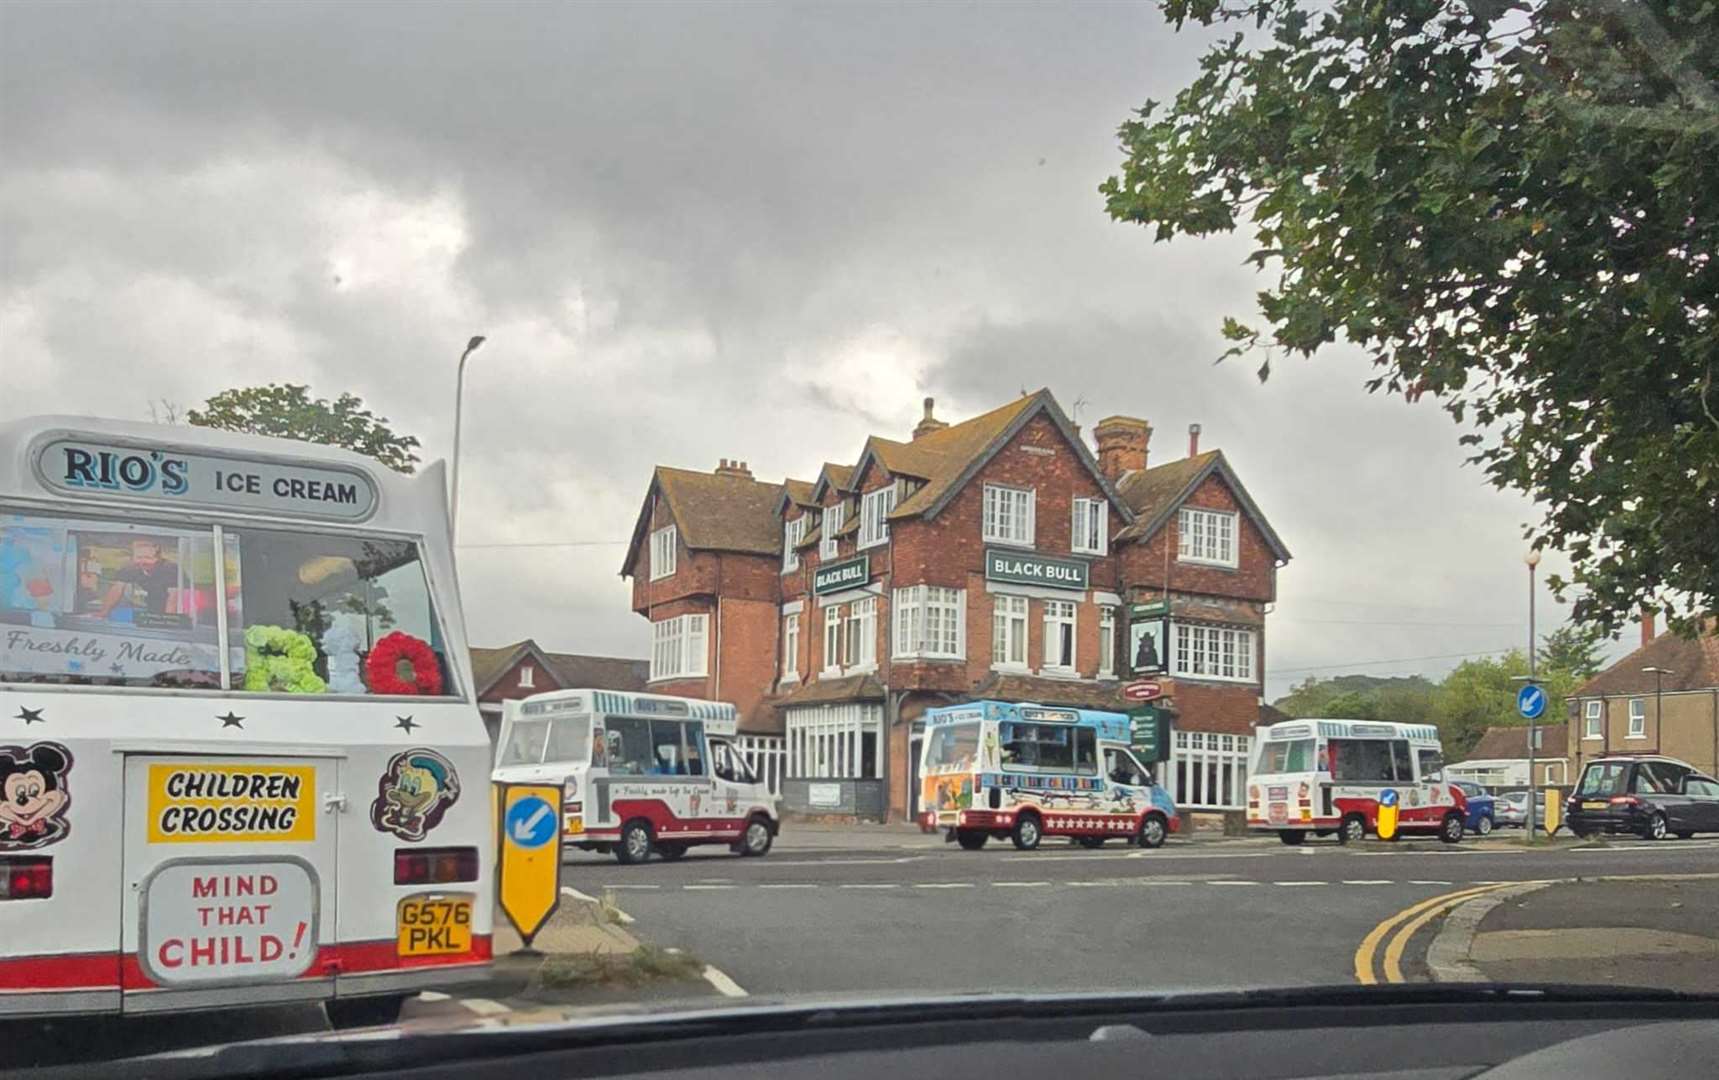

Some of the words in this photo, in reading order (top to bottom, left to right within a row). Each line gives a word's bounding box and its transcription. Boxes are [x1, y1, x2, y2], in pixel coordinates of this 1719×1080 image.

[63, 447, 189, 495] RIO'S
[216, 470, 261, 495] ICE
[273, 477, 358, 504] CREAM
[816, 569, 842, 588] BLACK
[842, 564, 863, 582] BULL
[994, 558, 1043, 577] BLACK
[1046, 565, 1082, 582] BULL
[7, 630, 107, 662] Freshly
[116, 641, 192, 665] Made
[167, 772, 301, 799] CHILDREN
[161, 806, 297, 833] CROSSING
[193, 875, 279, 899] MIND
[197, 905, 272, 927] THAT
[402, 902, 470, 925] G576
[159, 922, 308, 968] CHILD!
[409, 927, 461, 950] PKL
